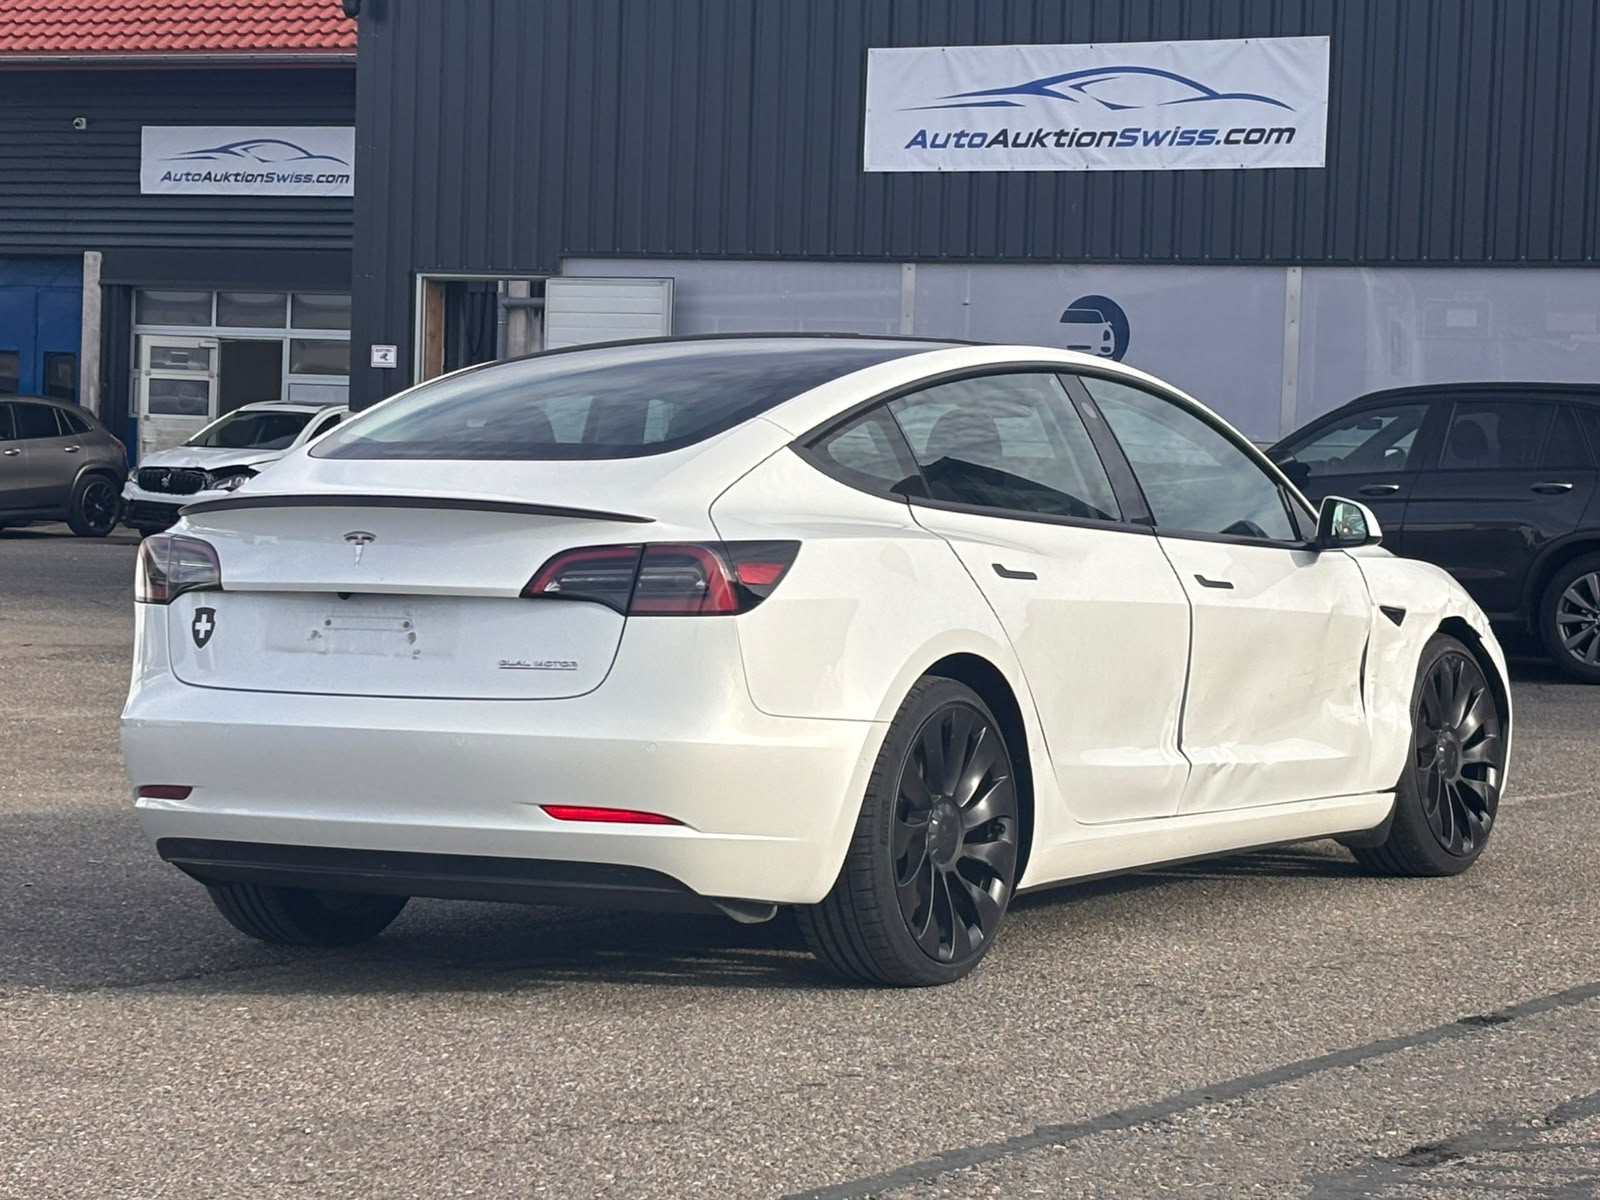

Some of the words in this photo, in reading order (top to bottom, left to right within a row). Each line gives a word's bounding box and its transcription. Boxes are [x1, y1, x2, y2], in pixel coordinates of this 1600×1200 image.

[905, 126, 1296, 150] AutoAuktionSwiss.com
[160, 171, 350, 184] AutoAuktionSwiss.com
[533, 660, 578, 668] MOTOR
